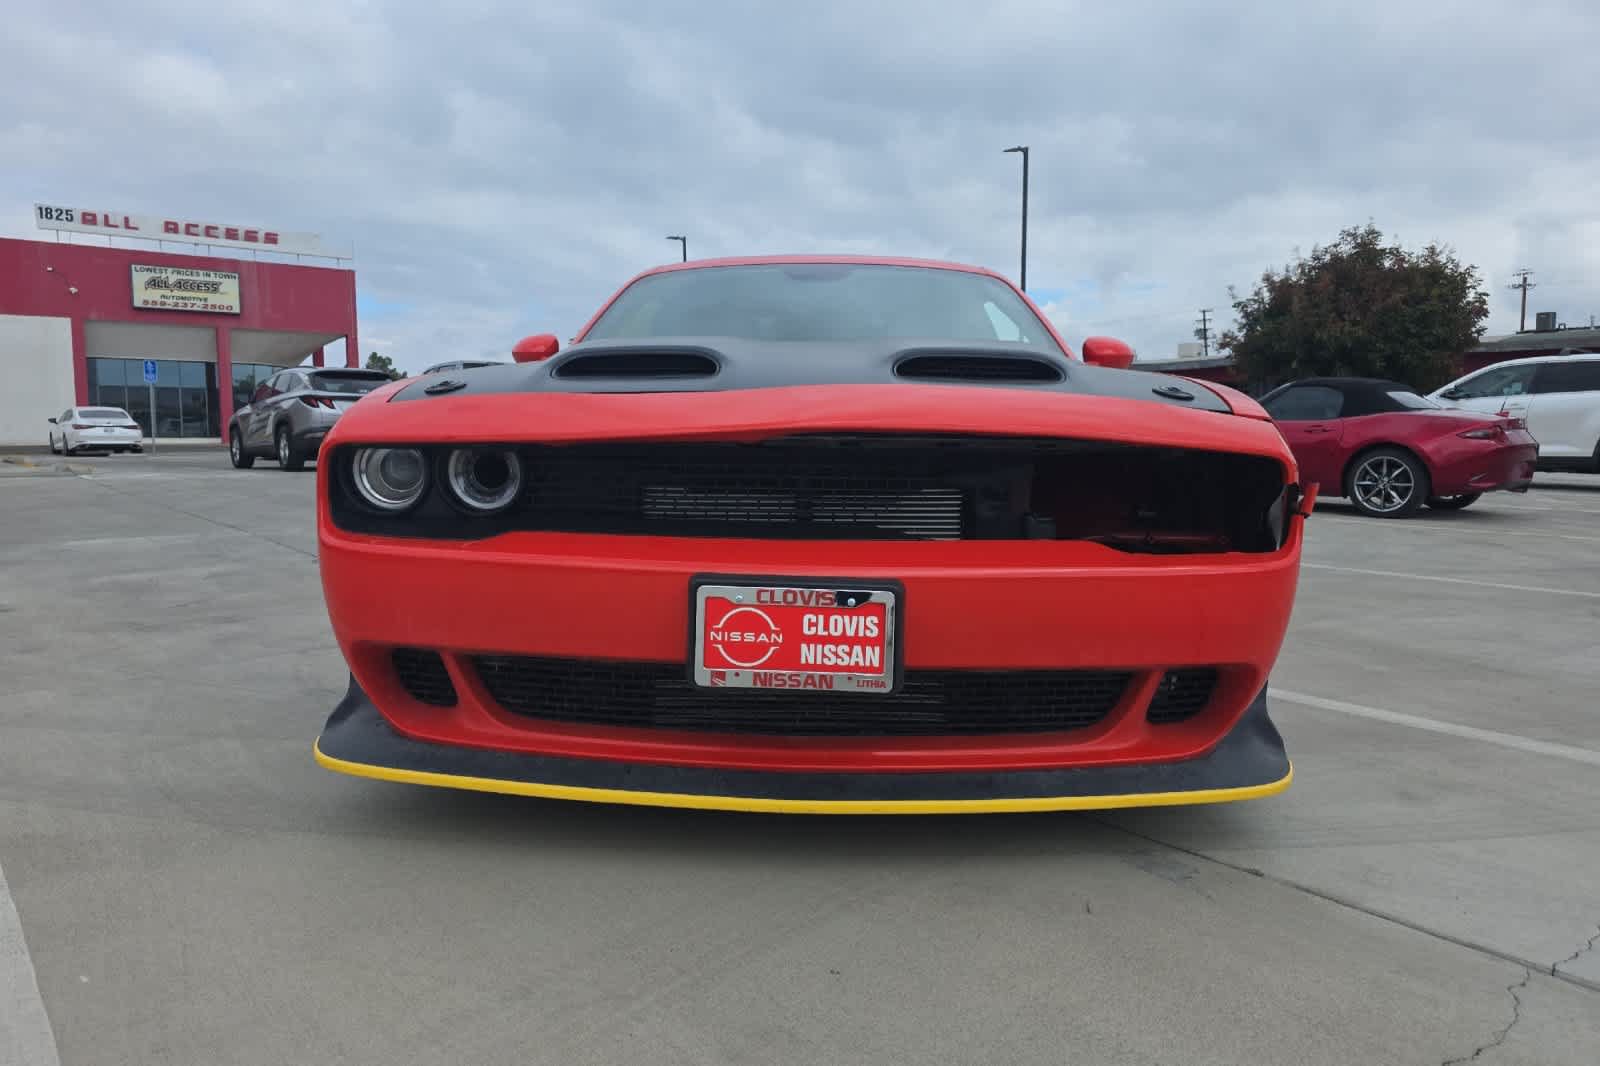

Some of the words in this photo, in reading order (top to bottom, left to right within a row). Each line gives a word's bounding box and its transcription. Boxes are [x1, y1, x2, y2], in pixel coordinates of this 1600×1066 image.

[38, 206, 74, 222] 1825
[81, 212, 139, 231] ALL
[164, 221, 279, 245] ACCESS
[134, 266, 169, 275] LOWEST
[171, 268, 200, 278] PRICES
[202, 271, 211, 279] IN
[213, 272, 237, 281] TOWN
[173, 279, 219, 293] ACCESS
[160, 294, 209, 303] AUTOMOTIVE
[756, 588, 836, 607] CLOVIS
[802, 613, 879, 638] CLOVIS
[710, 631, 783, 644] NISSAN
[800, 643, 880, 667] NISSAN
[752, 671, 834, 689] NISSAN
[856, 679, 887, 689] LITHIA
